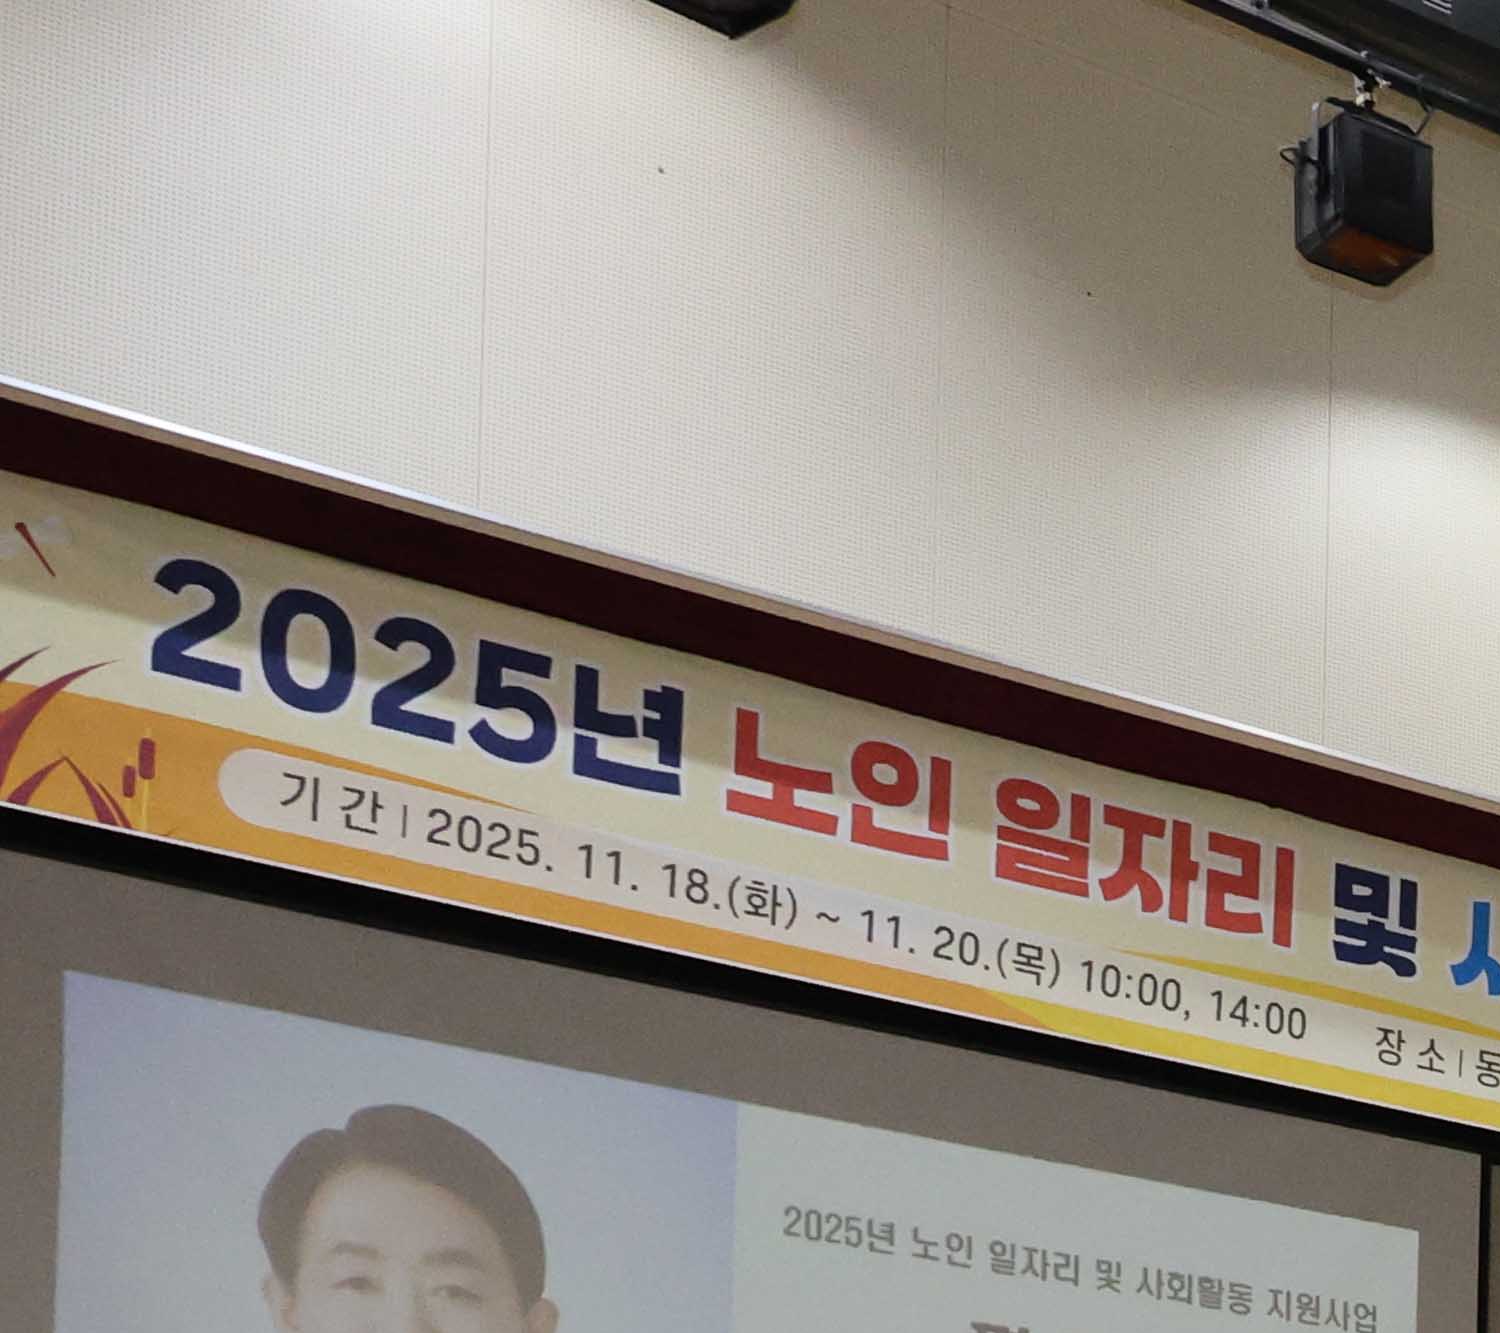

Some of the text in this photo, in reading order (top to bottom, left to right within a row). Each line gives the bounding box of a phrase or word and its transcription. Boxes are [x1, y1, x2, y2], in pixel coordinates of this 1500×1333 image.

[151, 558, 685, 796] 2025년
[726, 707, 951, 861] 노인
[994, 777, 1295, 947] 일자리
[1333, 863, 1418, 977] 및
[426, 808, 553, 872] 2025.
[577, 843, 639, 892] 11.
[661, 862, 798, 931] 18.(화)
[860, 909, 915, 954] 11.
[933, 925, 1061, 989] 20.(목)
[1080, 960, 1191, 1022] 10:00,
[1210, 991, 1307, 1040] 14:00
[782, 1205, 896, 1256] 2025년
[911, 1226, 974, 1269] 노인
[989, 1240, 1080, 1287] 일자리
[1095, 1259, 1123, 1294] 및
[1136, 1266, 1254, 1316] 사회활동
